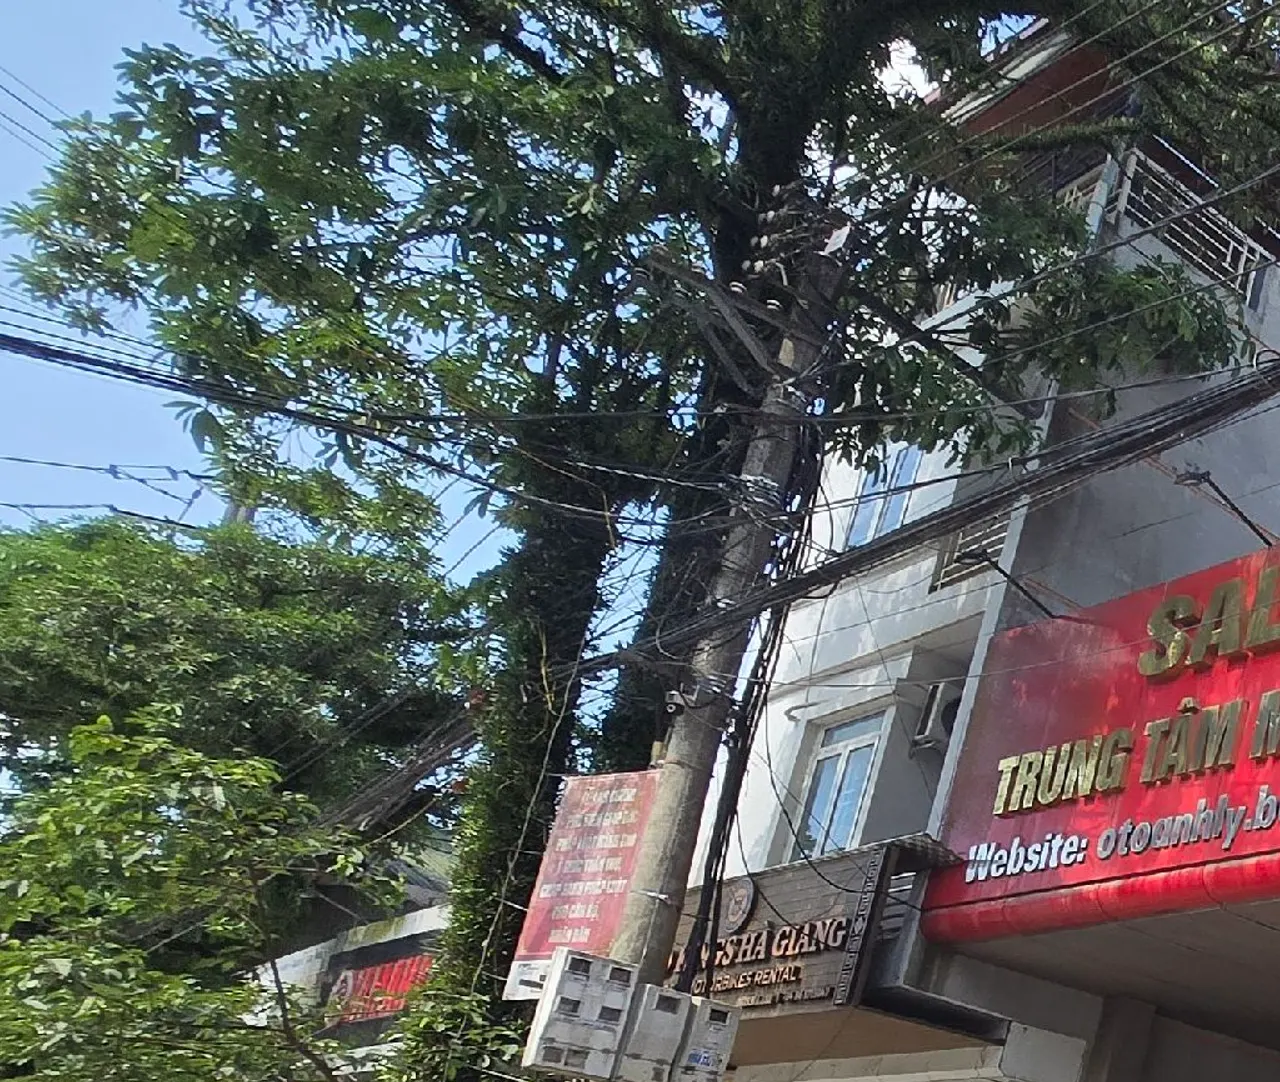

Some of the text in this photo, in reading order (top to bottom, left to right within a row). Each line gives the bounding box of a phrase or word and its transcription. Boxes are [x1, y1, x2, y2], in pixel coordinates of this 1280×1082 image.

[991, 725, 1132, 818] TRUNG
[1141, 695, 1247, 785] TÂM
[963, 835, 1088, 884] Website:
[771, 918, 846, 957] GIANG
[691, 971, 752, 997] OTRBIKES
[754, 965, 797, 986] RENTAL
